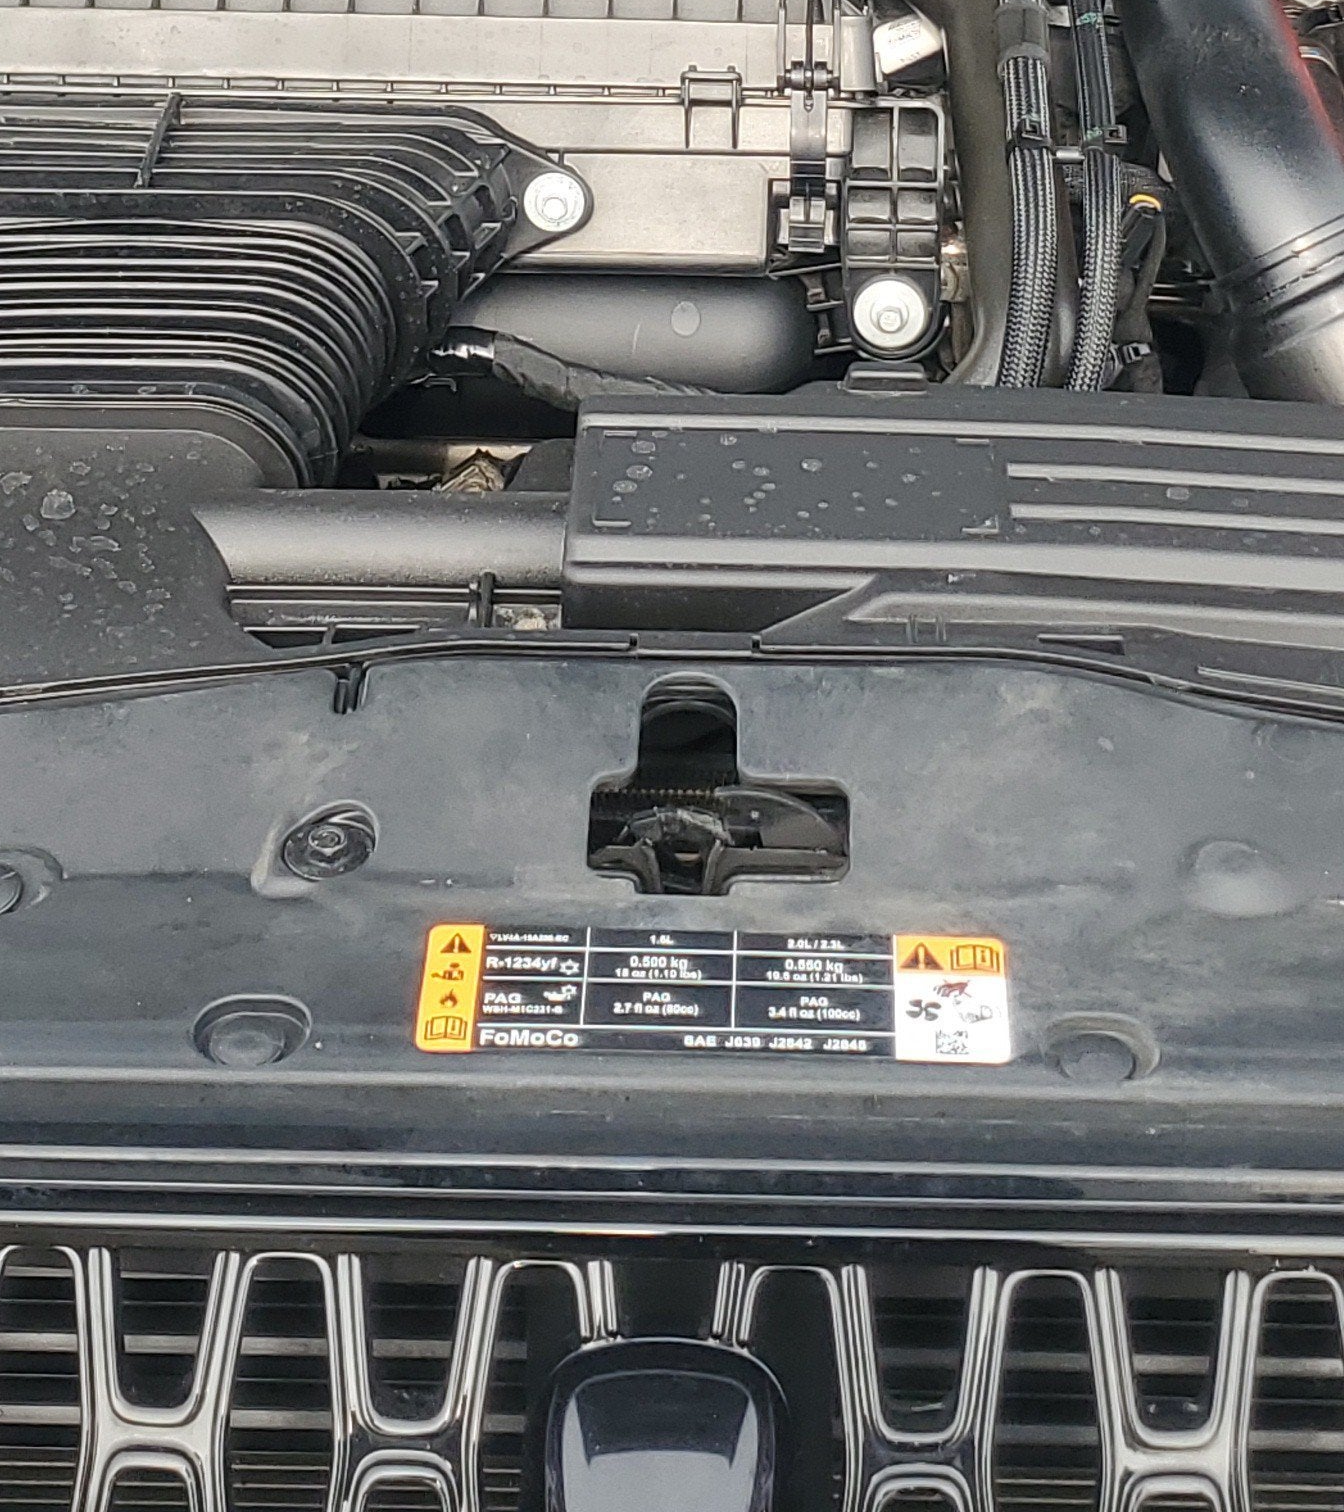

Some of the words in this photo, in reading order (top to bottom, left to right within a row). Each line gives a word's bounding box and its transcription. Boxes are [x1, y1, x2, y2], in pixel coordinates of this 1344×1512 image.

[670, 956, 688, 971] kg
[826, 959, 844, 973] kg
[793, 972, 807, 981] oz
[483, 992, 522, 1004] PAG
[799, 1009, 814, 1020] oz
[479, 1028, 578, 1046] FoMoCo
